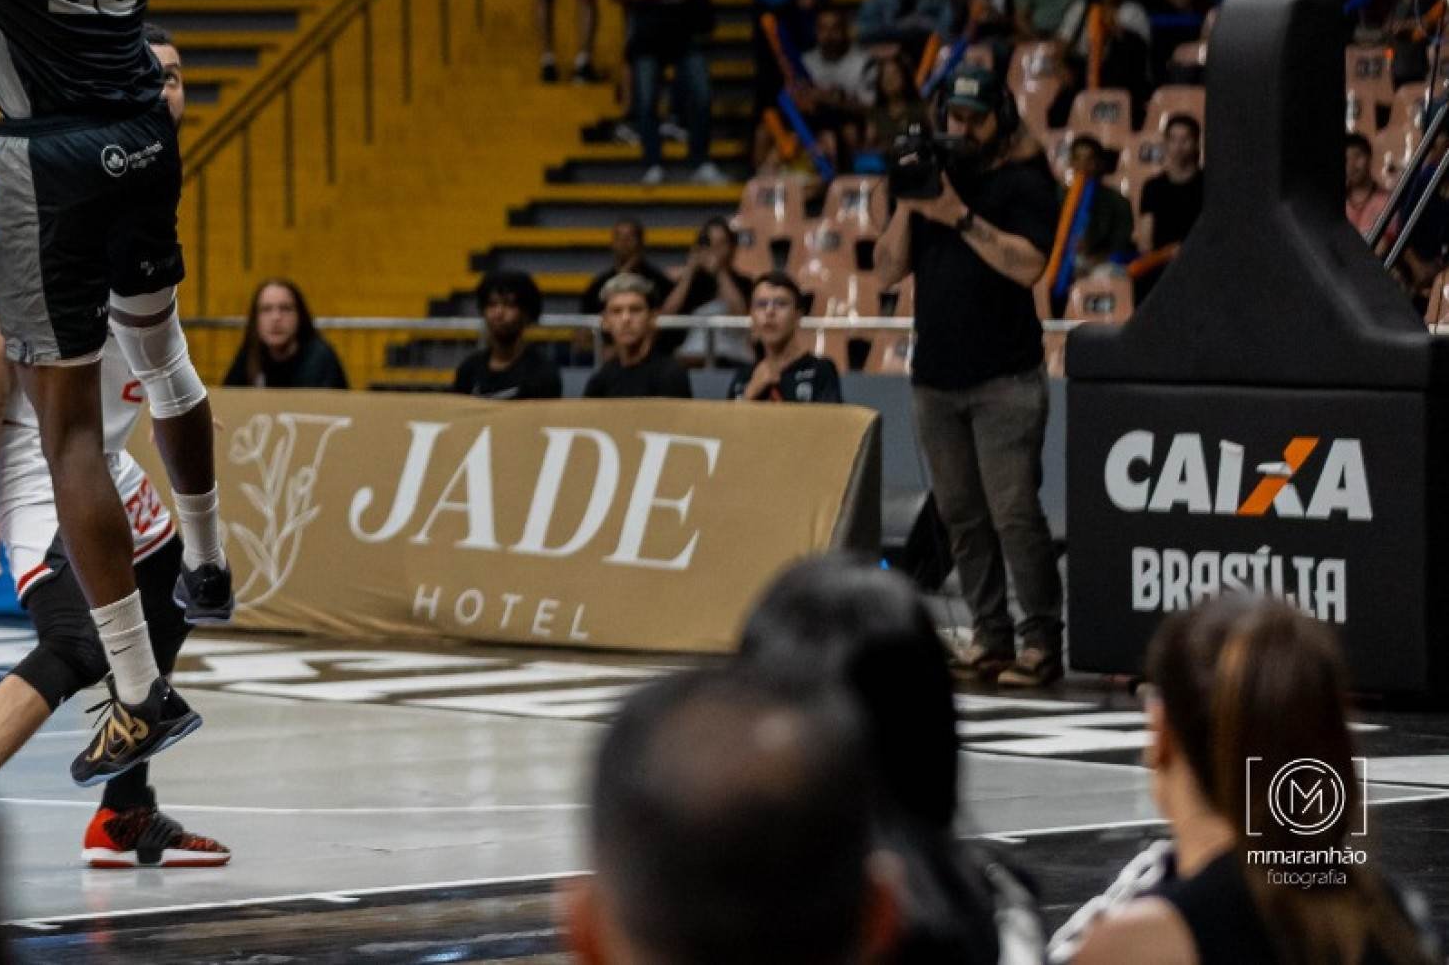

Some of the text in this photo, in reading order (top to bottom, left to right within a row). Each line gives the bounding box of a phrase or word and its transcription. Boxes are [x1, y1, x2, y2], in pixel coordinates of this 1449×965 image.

[350, 421, 722, 570] JADE
[1104, 428, 1373, 522] CAIXA
[413, 584, 591, 641] HOTEL
